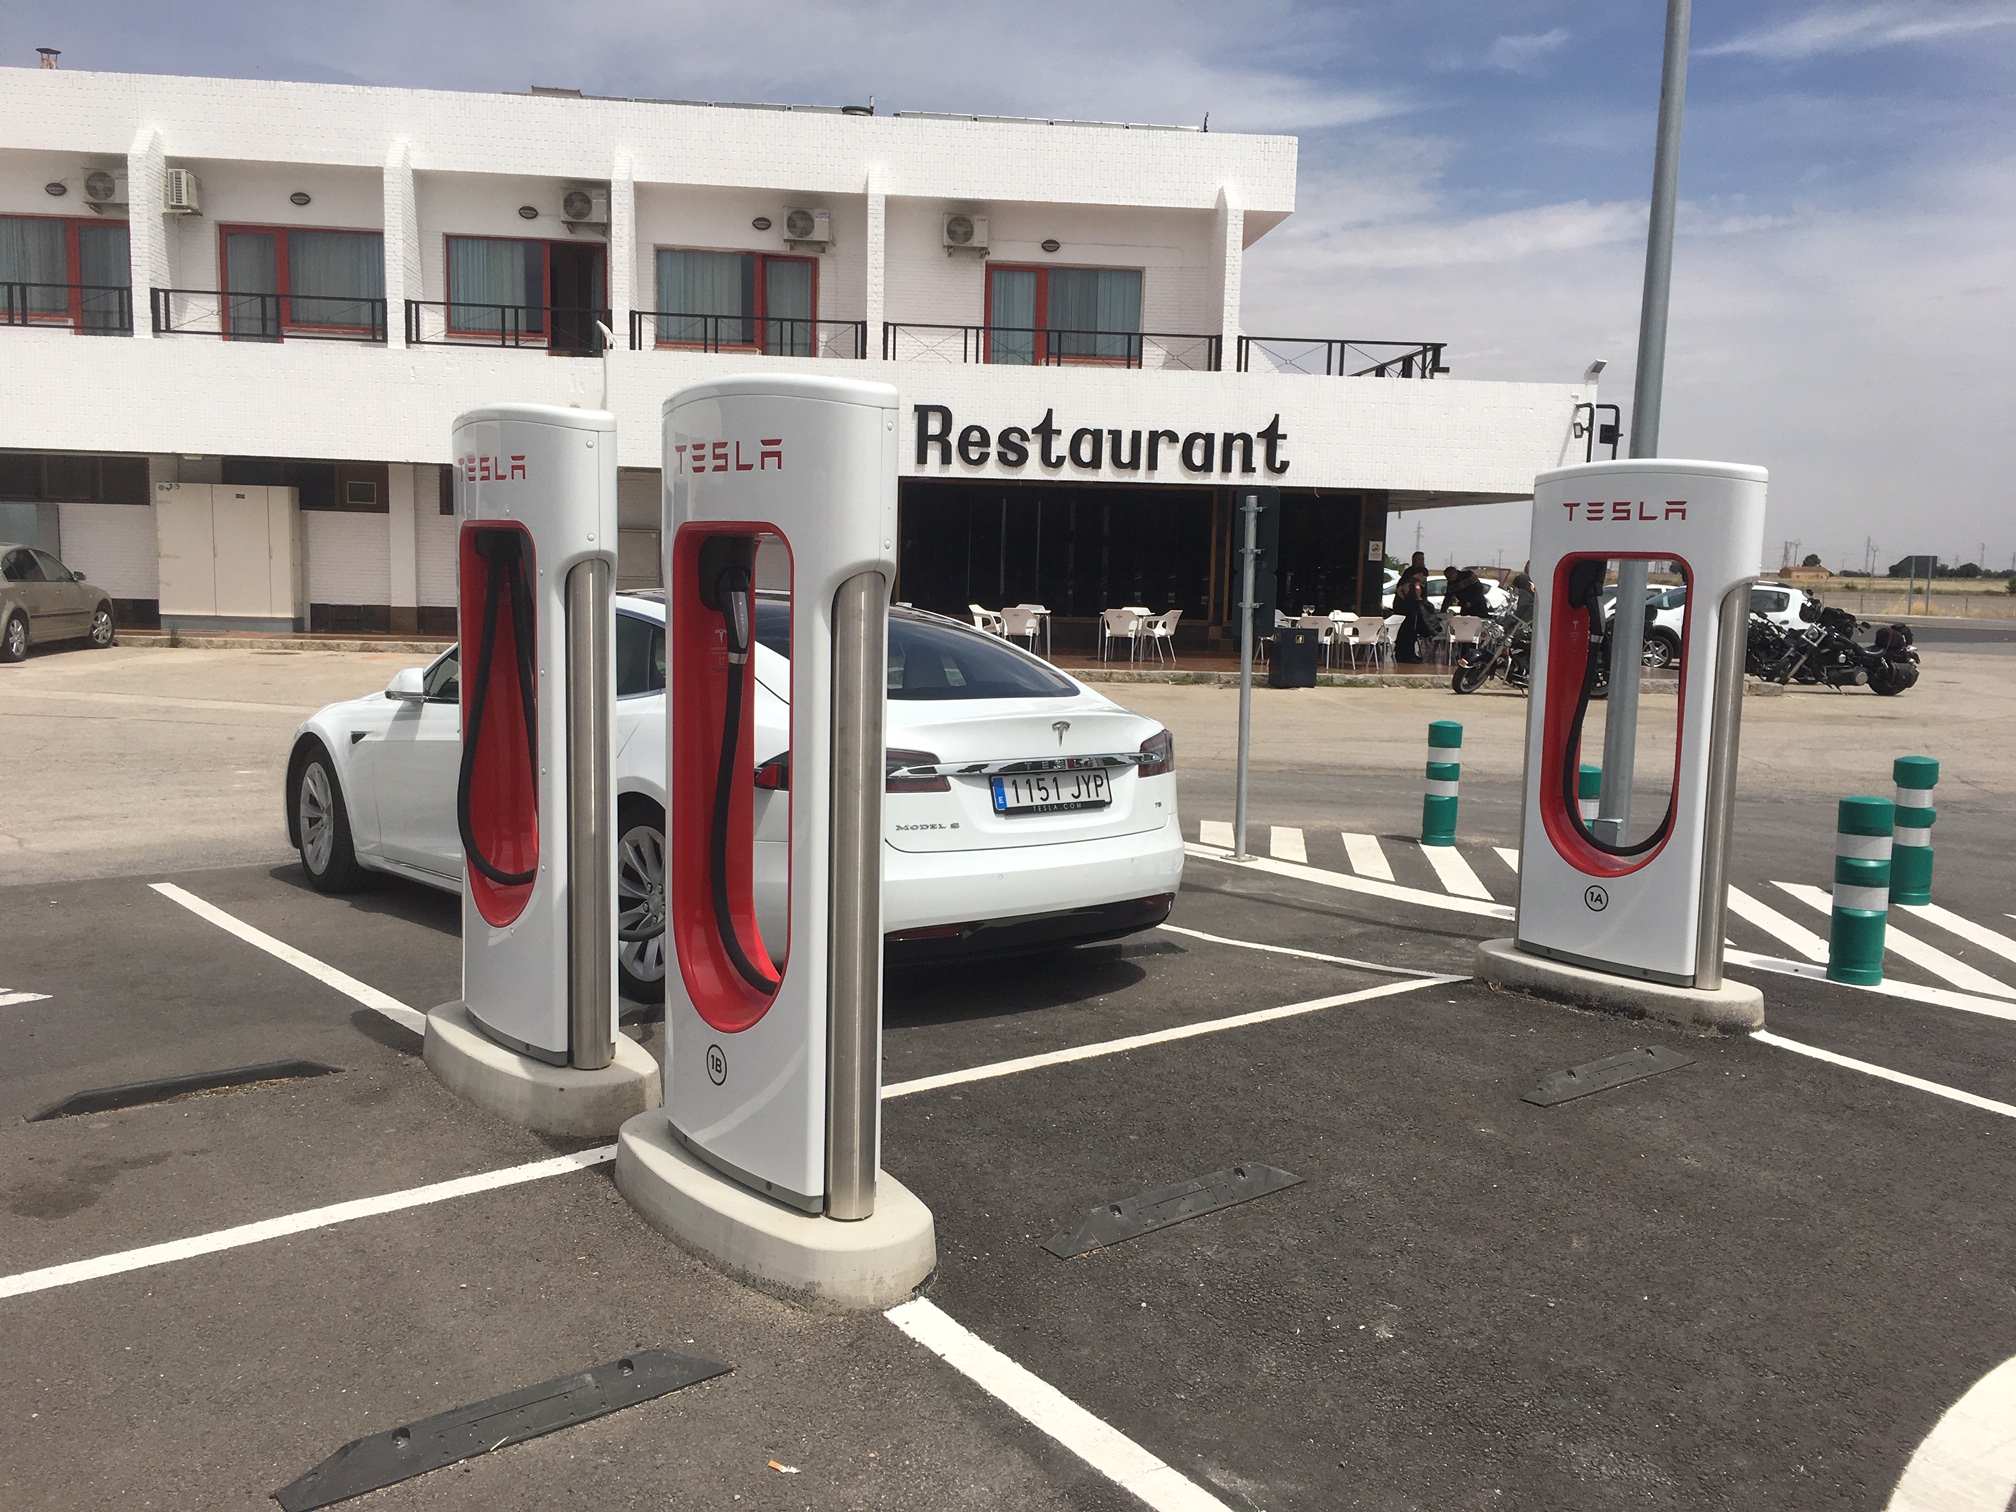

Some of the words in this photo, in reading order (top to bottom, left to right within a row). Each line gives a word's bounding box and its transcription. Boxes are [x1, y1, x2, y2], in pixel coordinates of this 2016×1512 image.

[914, 404, 1290, 475] Restaurant
[675, 438, 783, 475] TESLA
[457, 454, 526, 482] TESLA
[1563, 500, 1688, 521] TESLA
[1012, 776, 1061, 804] 1151
[1071, 774, 1104, 799] JYP
[1033, 802, 1082, 812] TESLA.COM
[895, 823, 947, 831] MODEL
[1590, 892, 1603, 904] 1A
[711, 1055, 722, 1073] 1B
